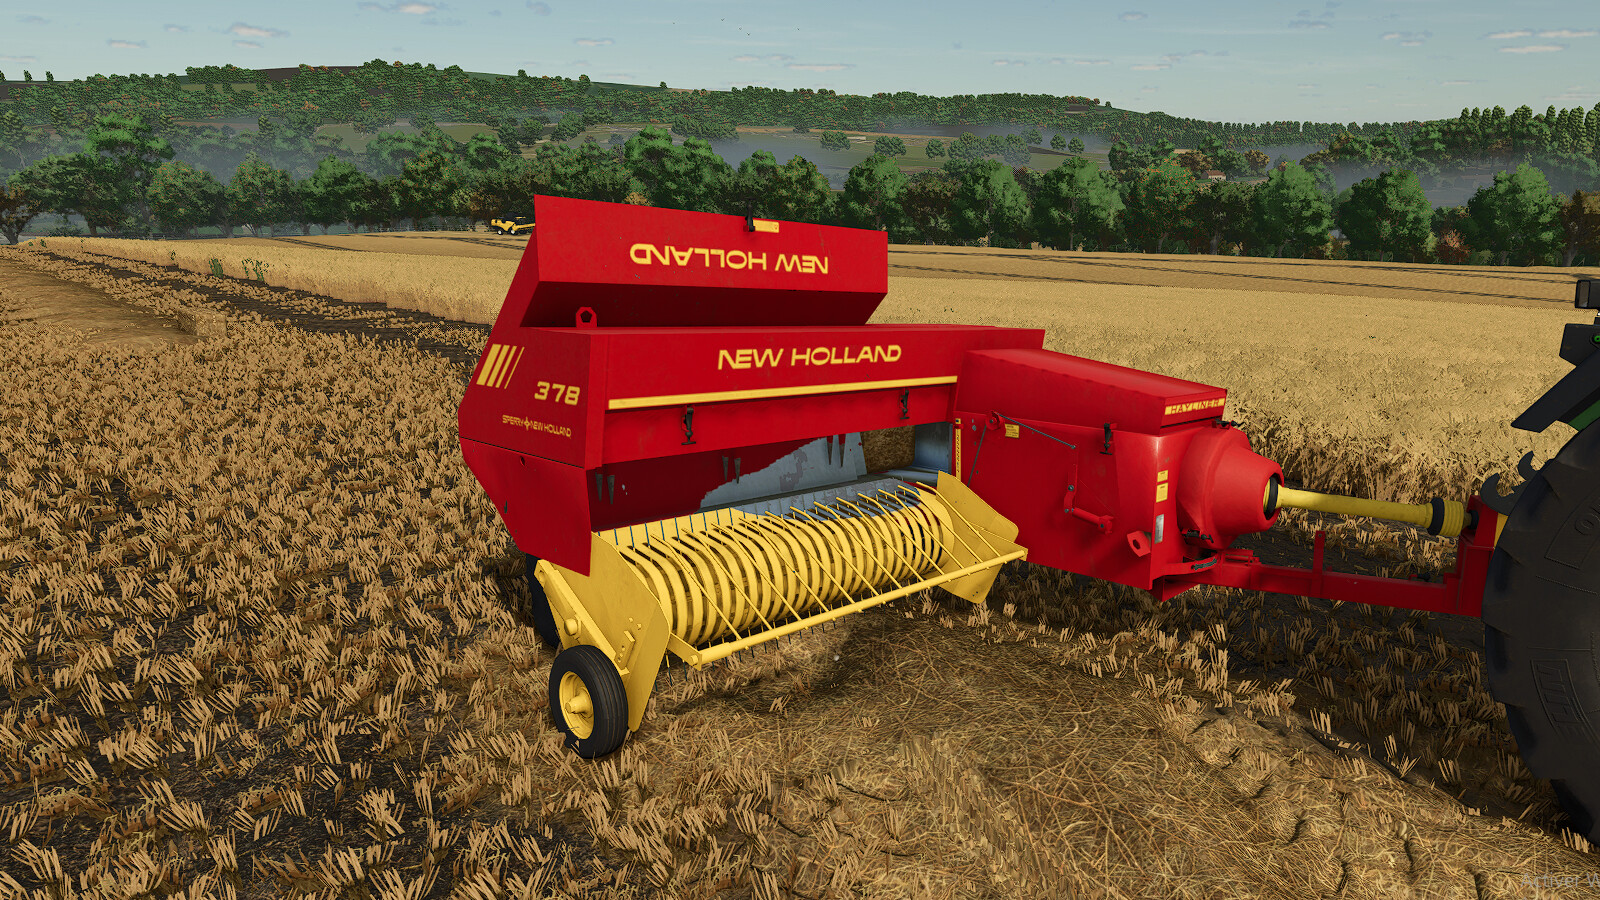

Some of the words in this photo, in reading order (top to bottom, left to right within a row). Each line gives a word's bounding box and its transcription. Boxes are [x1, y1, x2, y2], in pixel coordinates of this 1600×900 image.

[629, 243, 767, 271] HOLLAND
[775, 253, 829, 275] NEW
[717, 348, 784, 371] NEW
[790, 344, 902, 366] HOLLAND
[534, 381, 581, 406] 378
[1171, 399, 1219, 414] HAYLINER
[502, 414, 524, 427] SPERRY
[530, 420, 543, 432] NEW
[544, 423, 572, 438] HOLLAND
